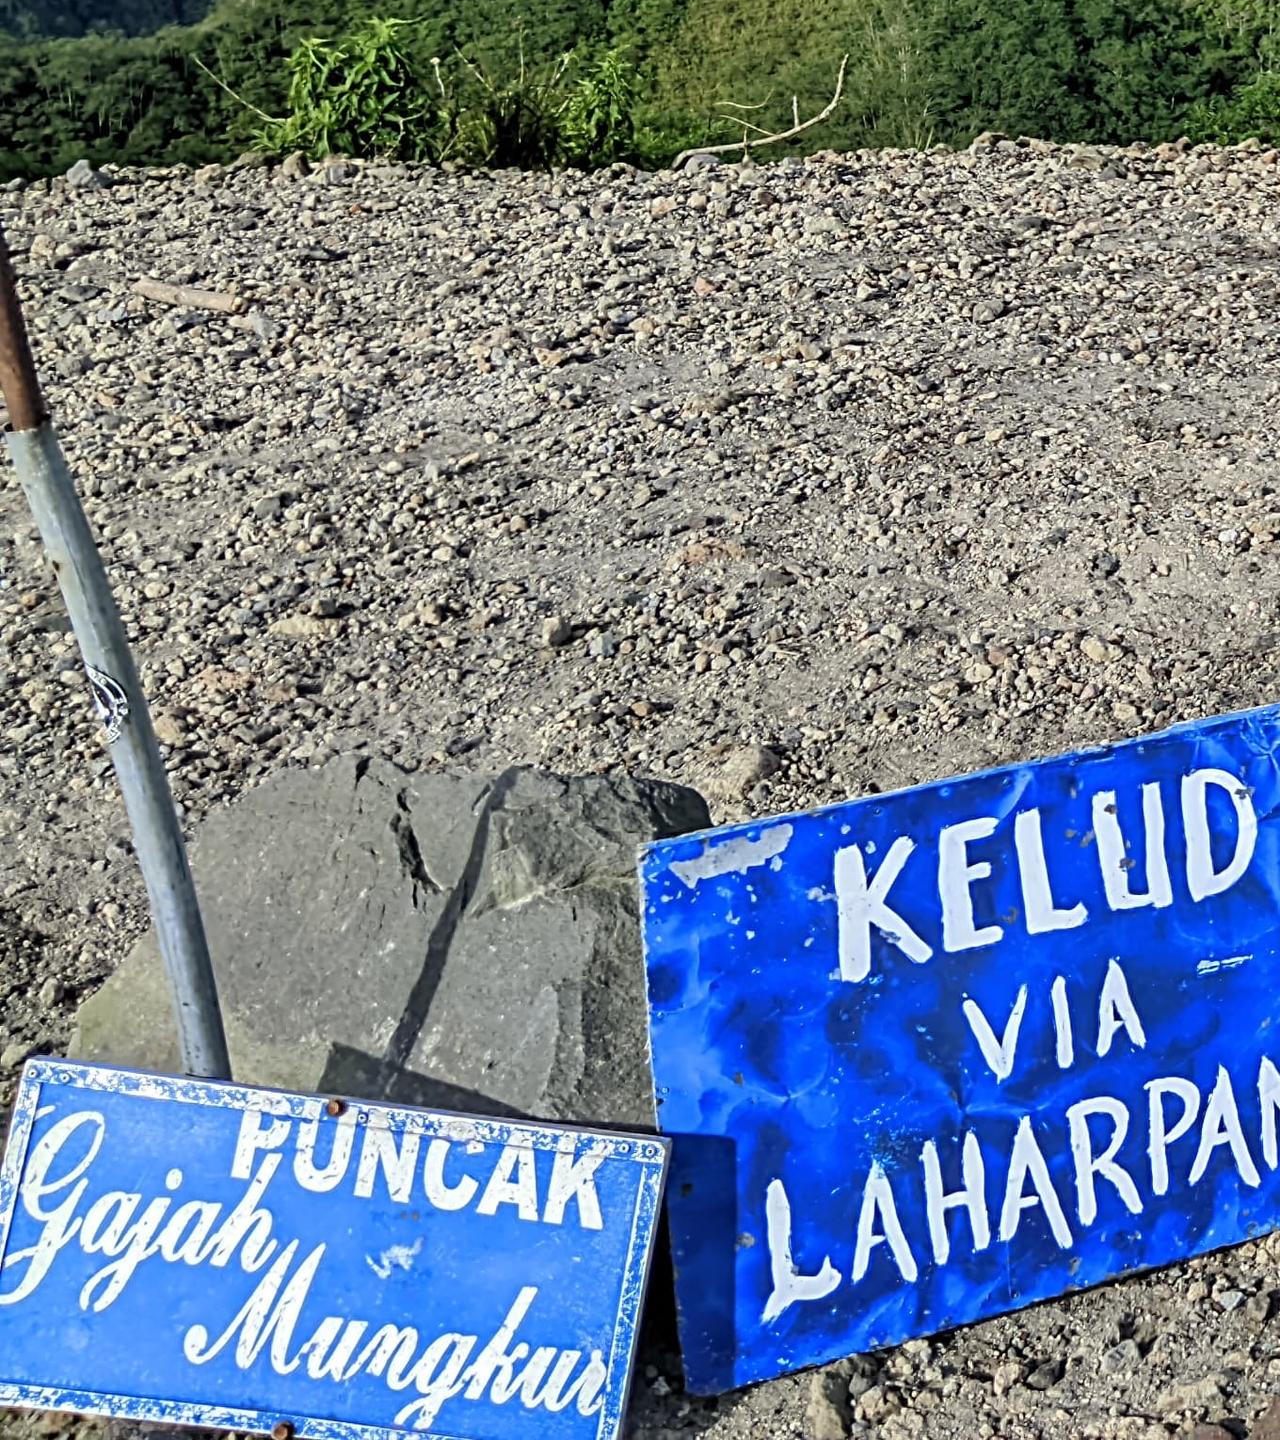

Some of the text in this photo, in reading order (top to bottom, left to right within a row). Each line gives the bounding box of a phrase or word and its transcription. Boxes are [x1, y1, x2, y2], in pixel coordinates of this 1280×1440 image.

[833, 768, 1257, 983] KELUD
[962, 959, 1146, 1083] VIA
[0, 1105, 283, 1313] Gajah
[231, 1095, 612, 1231] PUNCAK
[183, 1238, 607, 1430] Mungkur
